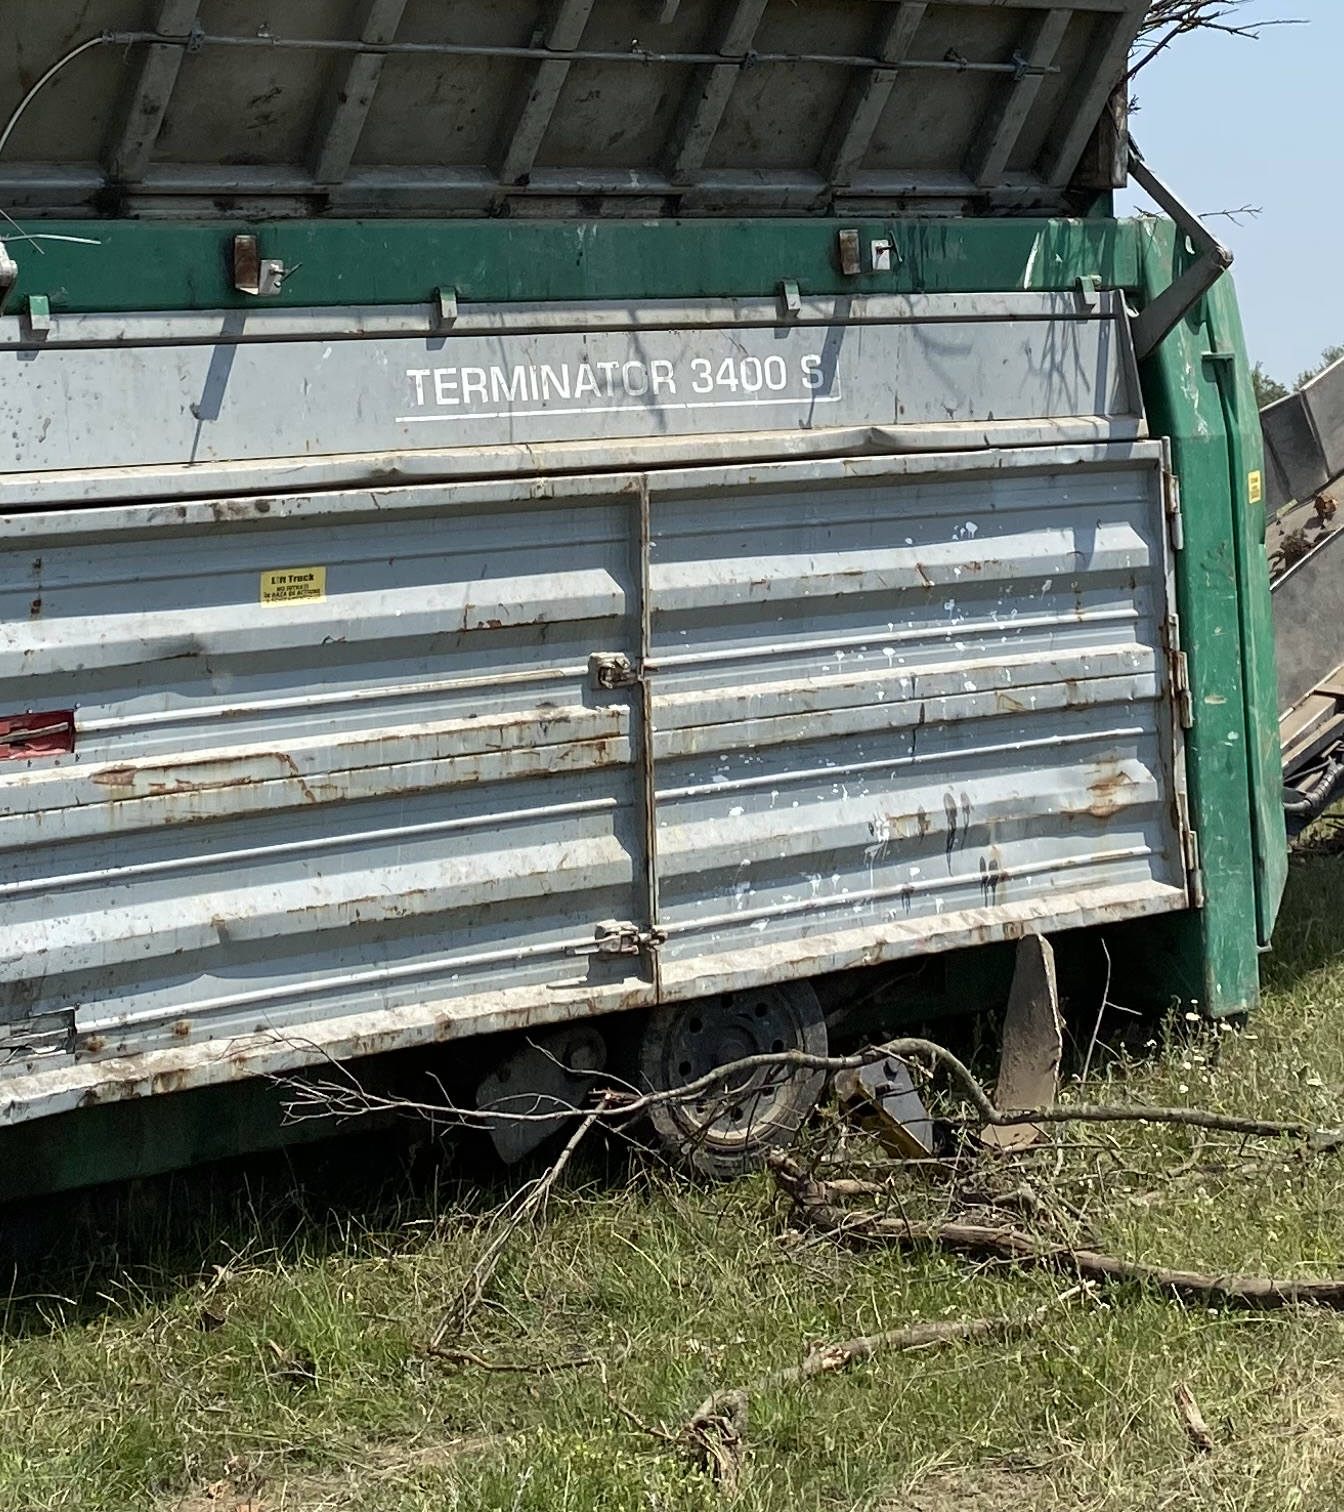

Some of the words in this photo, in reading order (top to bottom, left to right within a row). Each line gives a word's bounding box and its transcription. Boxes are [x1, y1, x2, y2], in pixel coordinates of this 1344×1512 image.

[406, 359, 677, 405] TERMINATOR
[690, 355, 787, 393] 3400
[800, 354, 824, 389] S
[288, 573, 314, 583] Truck
